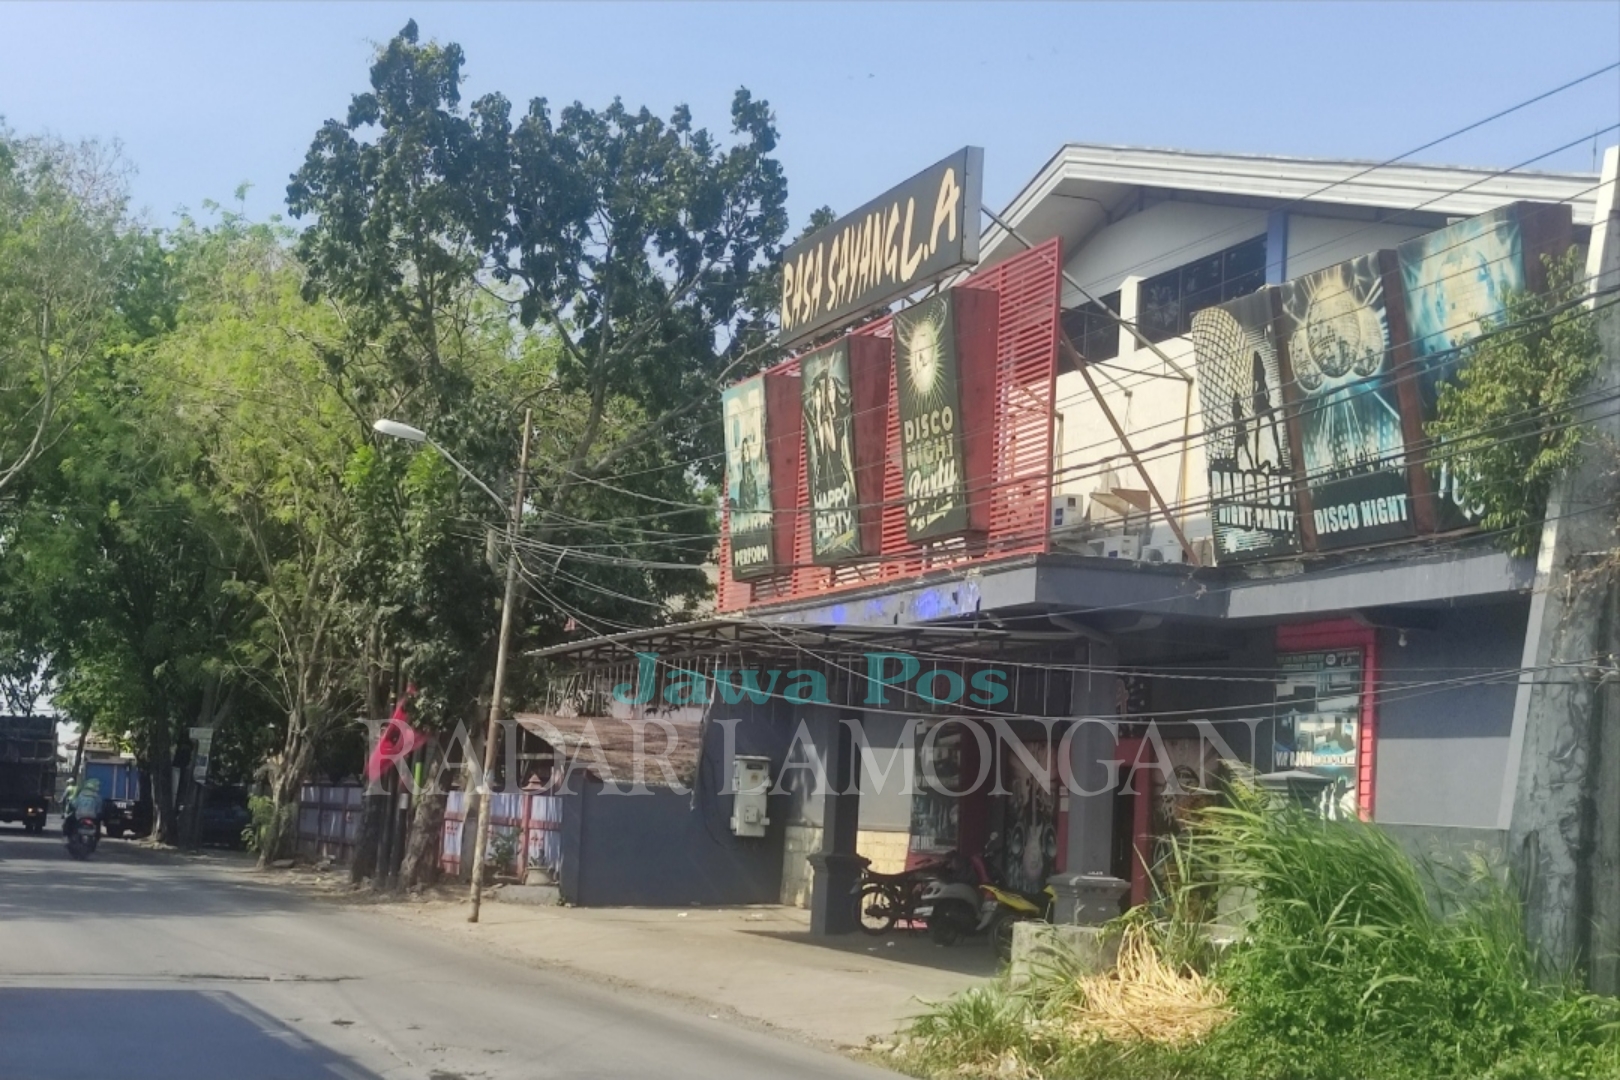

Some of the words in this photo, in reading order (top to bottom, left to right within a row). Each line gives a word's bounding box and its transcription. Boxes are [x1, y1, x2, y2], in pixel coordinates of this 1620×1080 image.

[781, 241, 822, 332] RASA
[827, 202, 900, 312] SAYANG
[904, 406, 953, 443] DISCO
[906, 433, 954, 469] NIGHT
[1218, 503, 1252, 527] NIGHT
[1255, 508, 1294, 532] PARTY
[1314, 502, 1359, 535] DISCO
[1360, 494, 1408, 528] NIGHT
[734, 544, 769, 568] PERFORM
